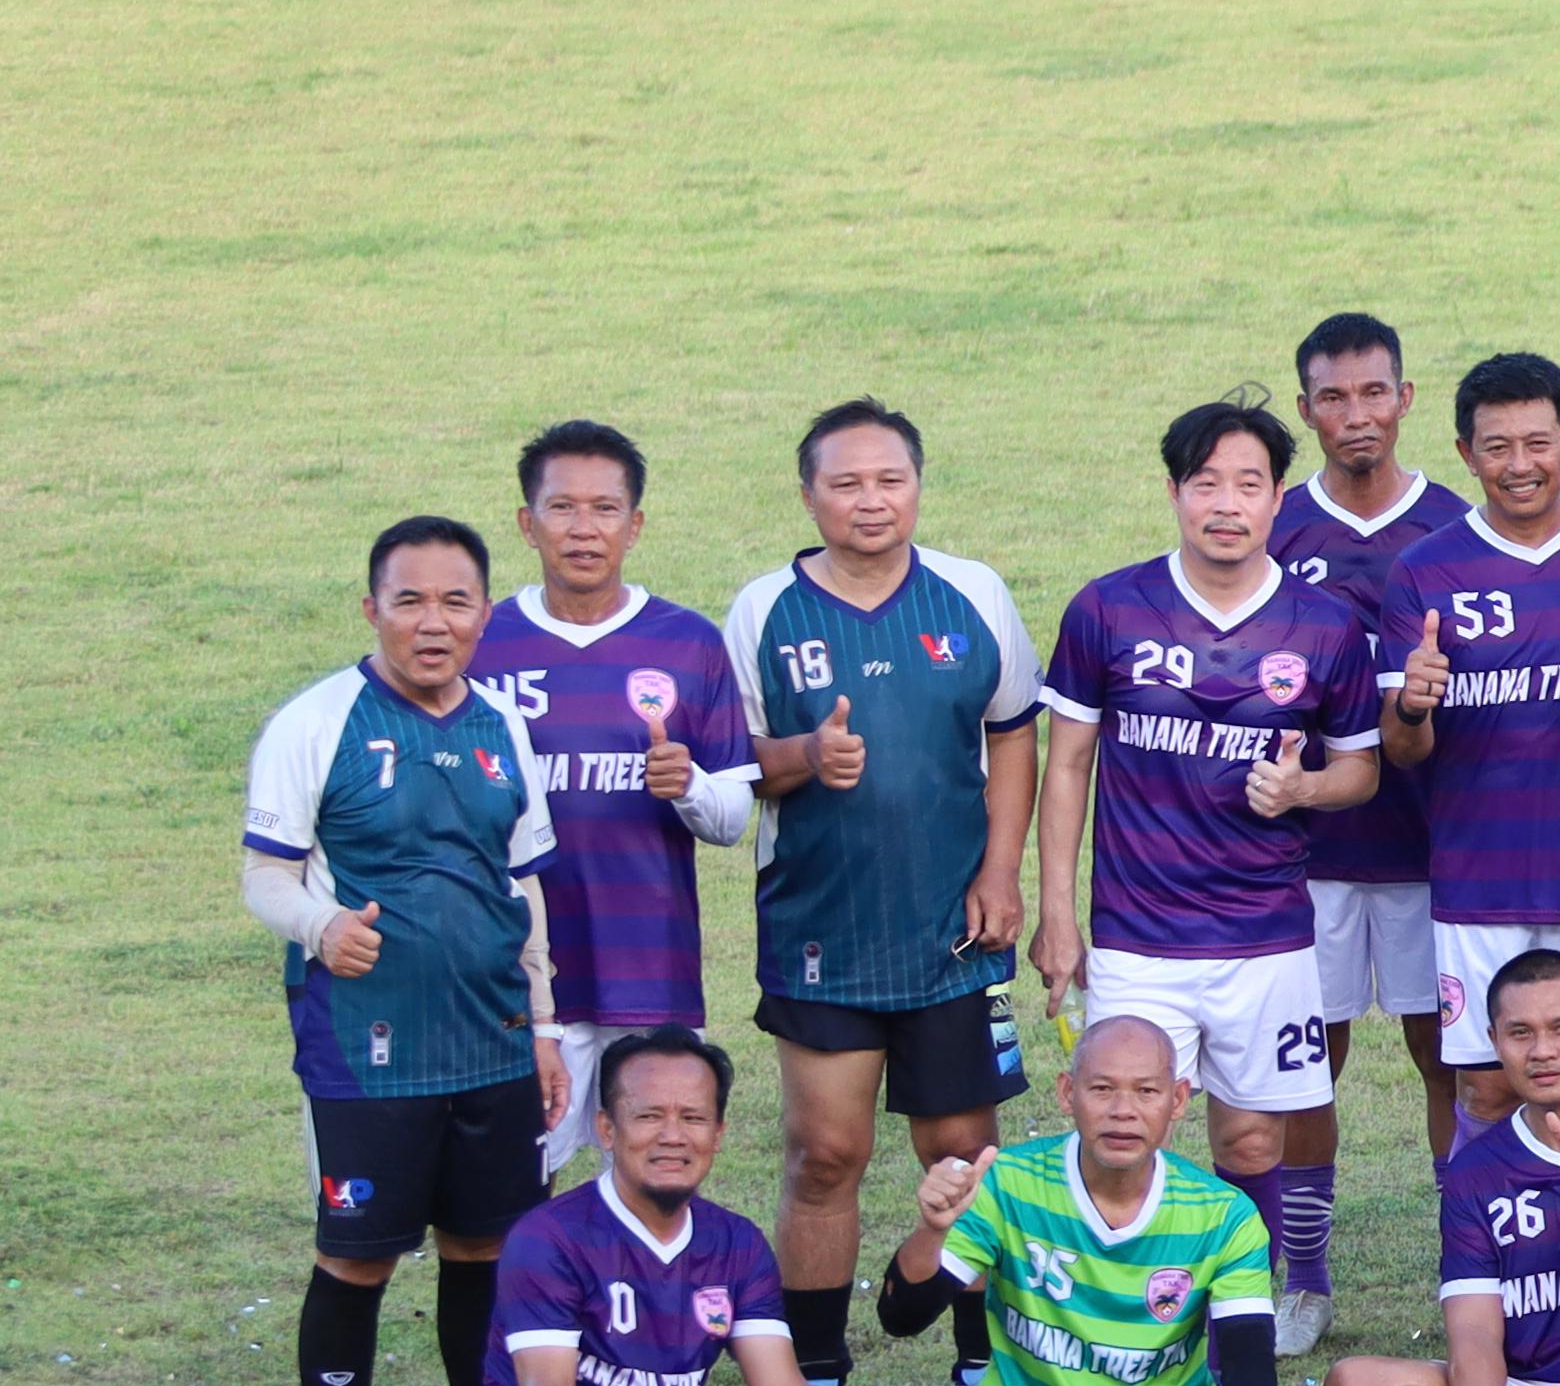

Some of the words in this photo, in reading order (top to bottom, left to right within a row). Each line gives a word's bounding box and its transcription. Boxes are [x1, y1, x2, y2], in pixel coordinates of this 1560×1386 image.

[1451, 588, 1517, 641] 53
[1131, 638, 1195, 691] 29
[1116, 709, 1202, 757] BANANA
[1206, 721, 1274, 763] TREE
[578, 752, 649, 795] TREE
[1276, 1015, 1328, 1073] 29
[1486, 1188, 1546, 1246] 26
[1024, 1240, 1083, 1302] 35
[1004, 1305, 1083, 1371] BANANA
[1088, 1340, 1150, 1385] TREE
